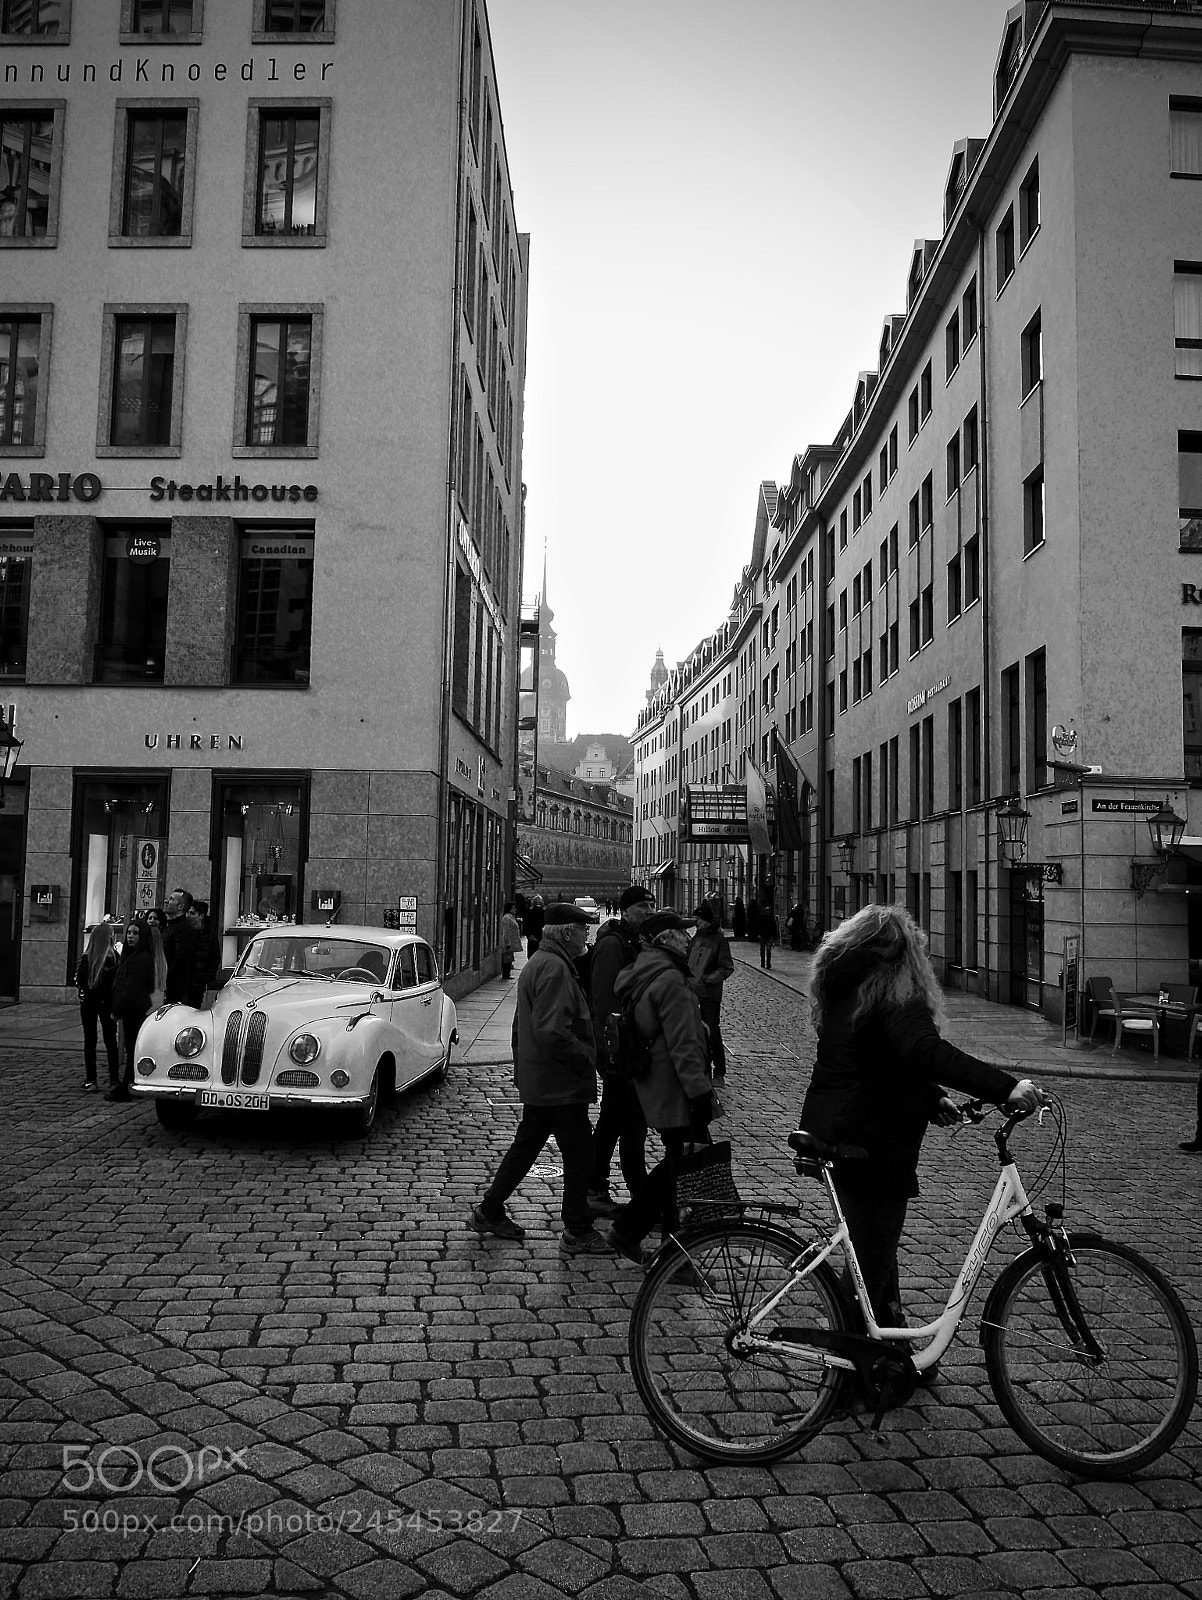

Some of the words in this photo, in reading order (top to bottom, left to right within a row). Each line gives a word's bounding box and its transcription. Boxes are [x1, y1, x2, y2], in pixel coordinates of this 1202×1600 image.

[5, 58, 334, 82] nnundKnoedler
[0, 472, 102, 502] ARIO
[150, 475, 319, 503] Steakhouse
[134, 538, 157, 547] Live-
[251, 544, 306, 554] Canadian
[129, 547, 157, 556] Musik
[145, 734, 243, 750] UHREN
[1096, 802, 1107, 810] An
[1108, 802, 1119, 810] der
[1120, 802, 1160, 811] Frauenkirche
[202, 1092, 217, 1105] DD
[244, 1095, 268, 1109] 20H
